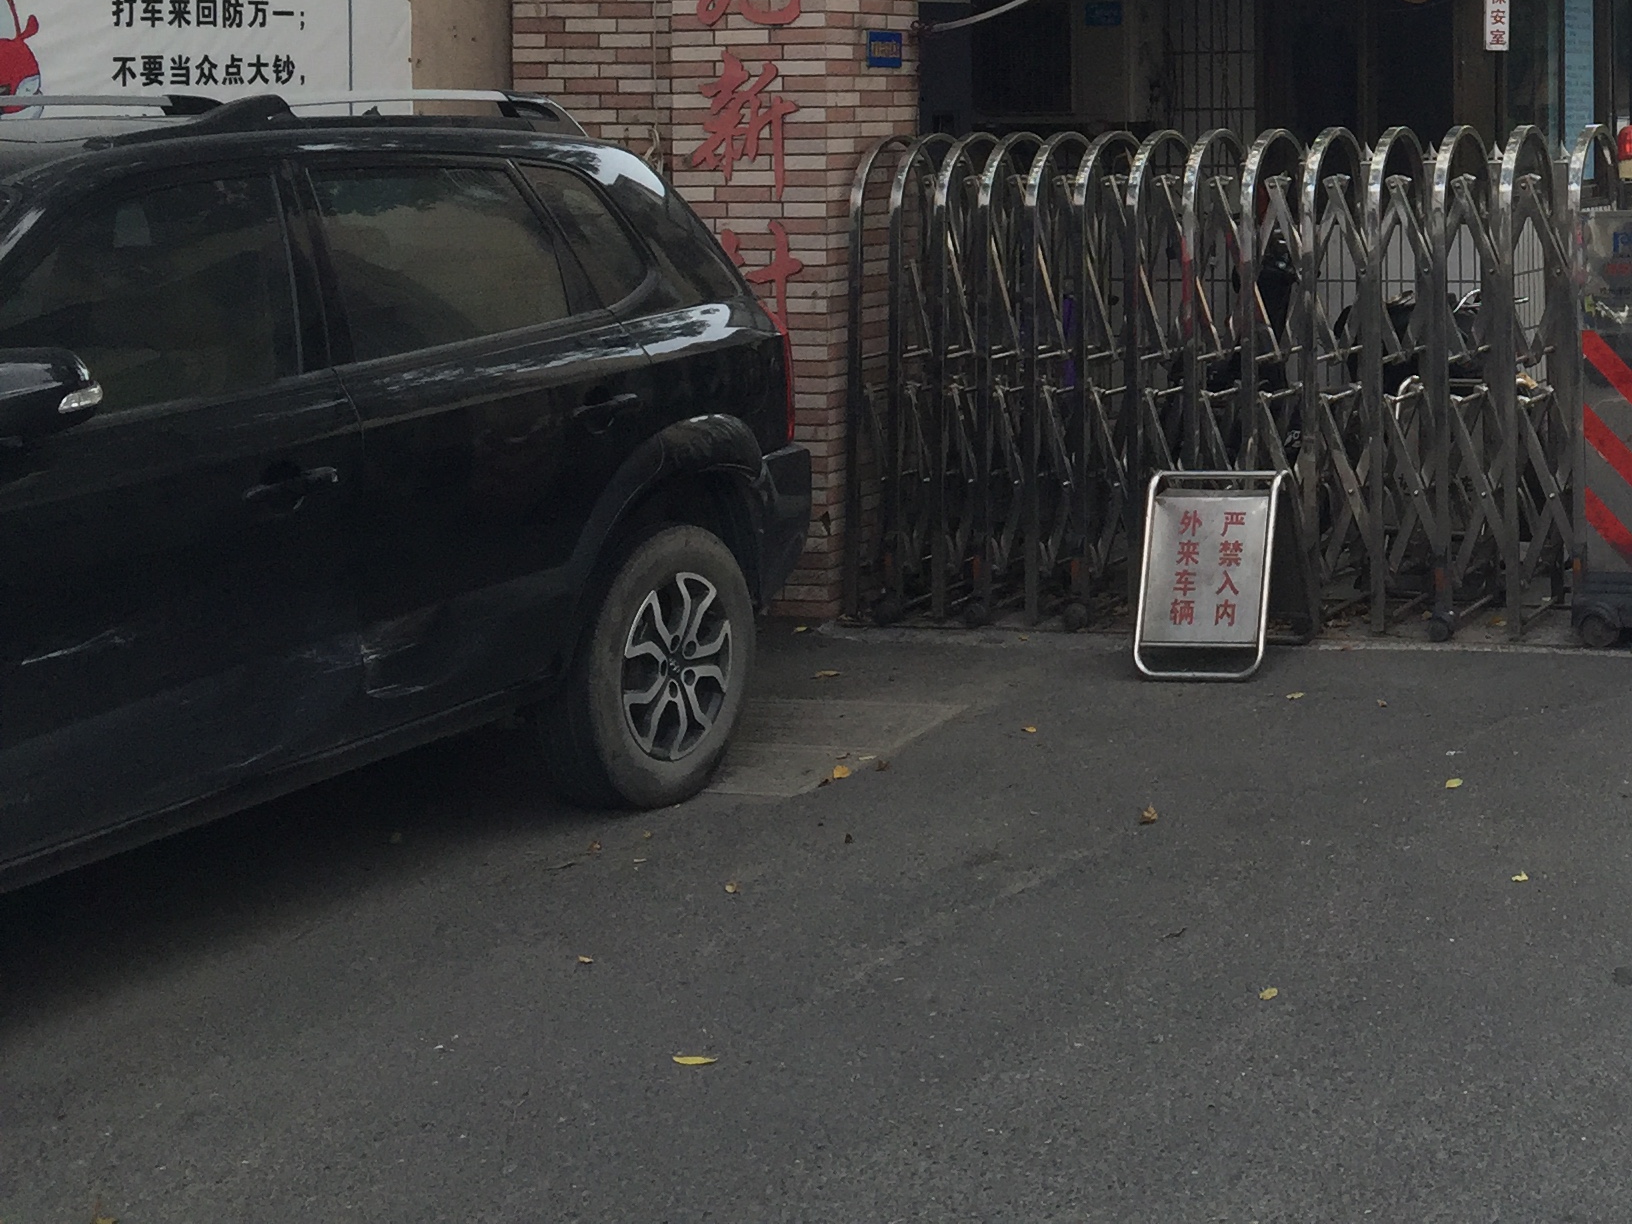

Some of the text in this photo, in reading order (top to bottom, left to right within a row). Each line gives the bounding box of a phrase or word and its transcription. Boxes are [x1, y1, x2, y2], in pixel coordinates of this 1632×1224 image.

[112, 55, 306, 87] 不要当众点大钞，
[1169, 509, 1203, 626] 外来车辆
[1214, 511, 1247, 627] 严禁入内
